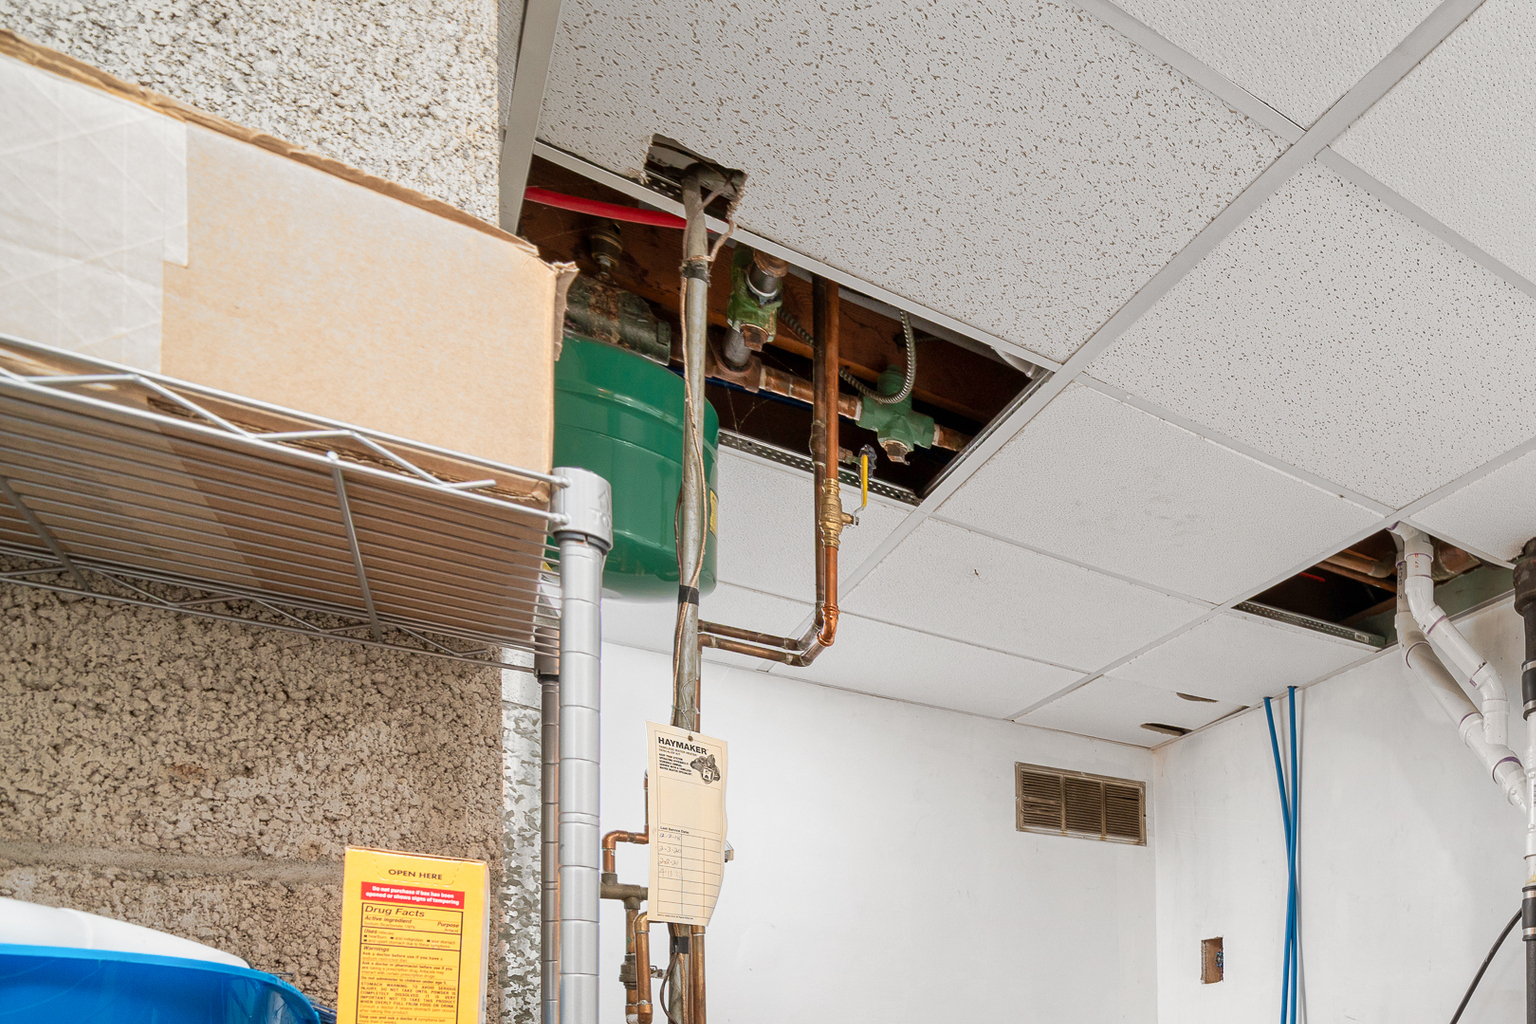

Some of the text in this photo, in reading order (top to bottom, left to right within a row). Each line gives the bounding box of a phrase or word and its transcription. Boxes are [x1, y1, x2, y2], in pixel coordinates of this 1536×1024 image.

[658, 736, 707, 755] HAYMAKER
[388, 869, 442, 880] OPEN HERE
[433, 898, 459, 906] tampering
[365, 905, 425, 917] Drug Facts
